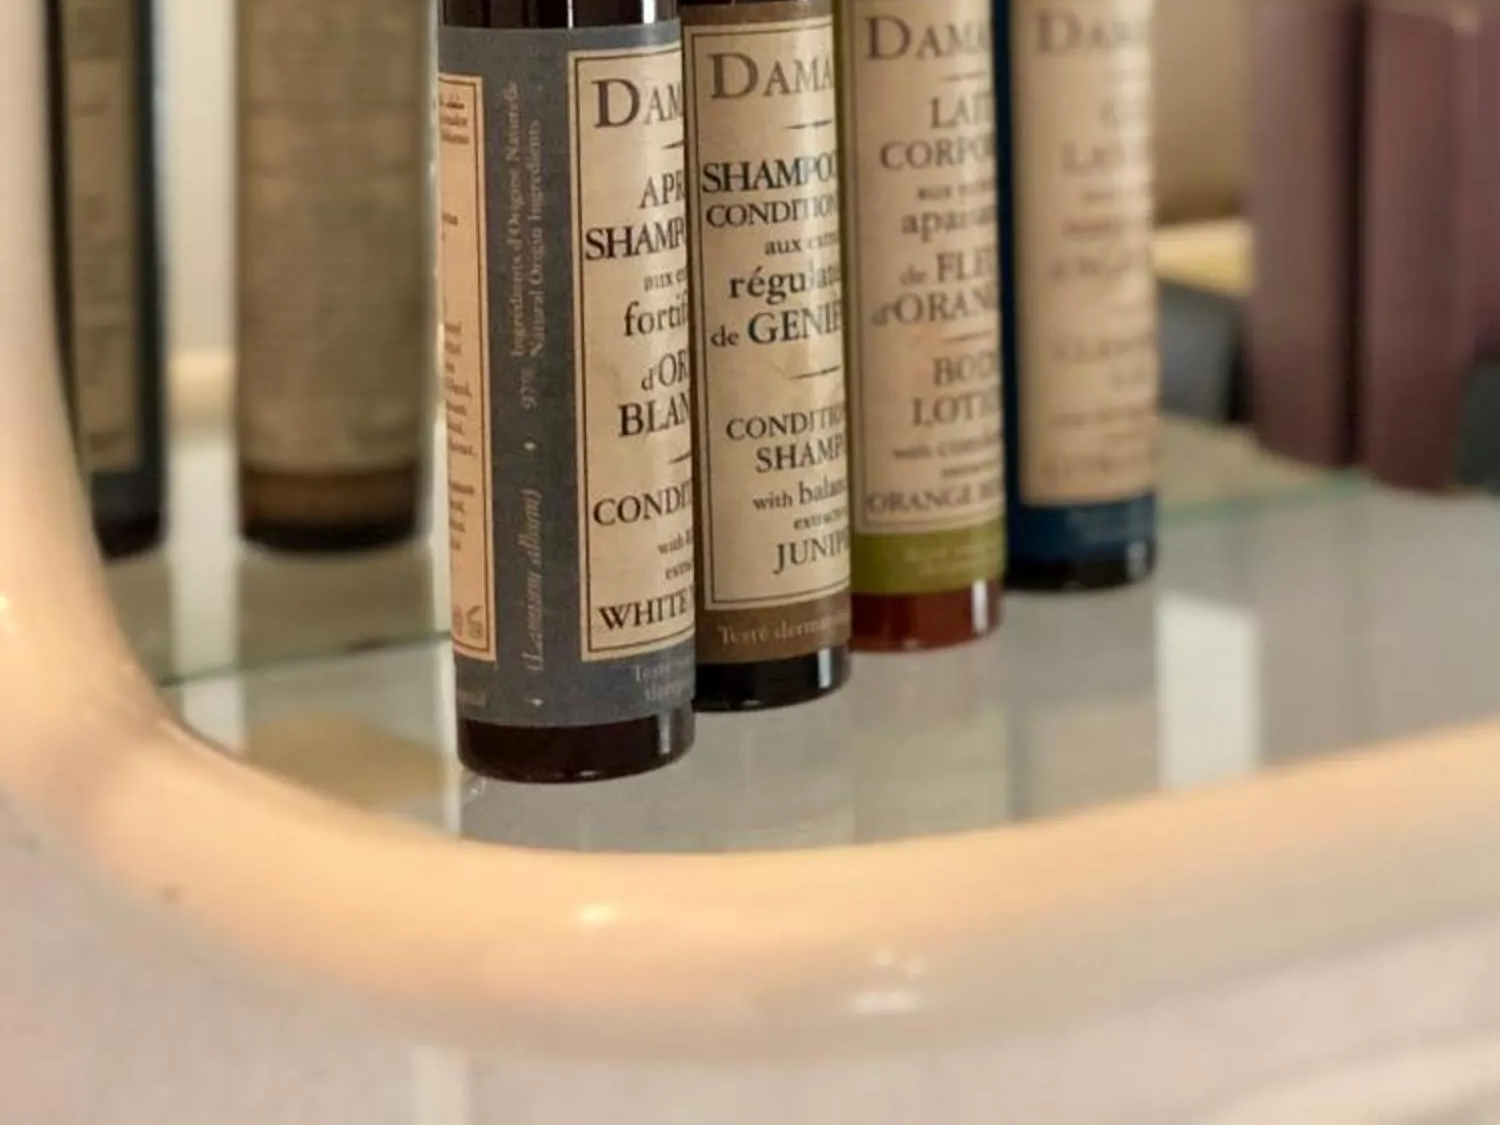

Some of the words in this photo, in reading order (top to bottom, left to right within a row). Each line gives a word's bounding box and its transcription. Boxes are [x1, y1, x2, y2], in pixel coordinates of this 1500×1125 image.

[764, 239, 801, 256] aux
[710, 324, 740, 347] de
[753, 491, 793, 512] with
[597, 588, 687, 630] WHITE
